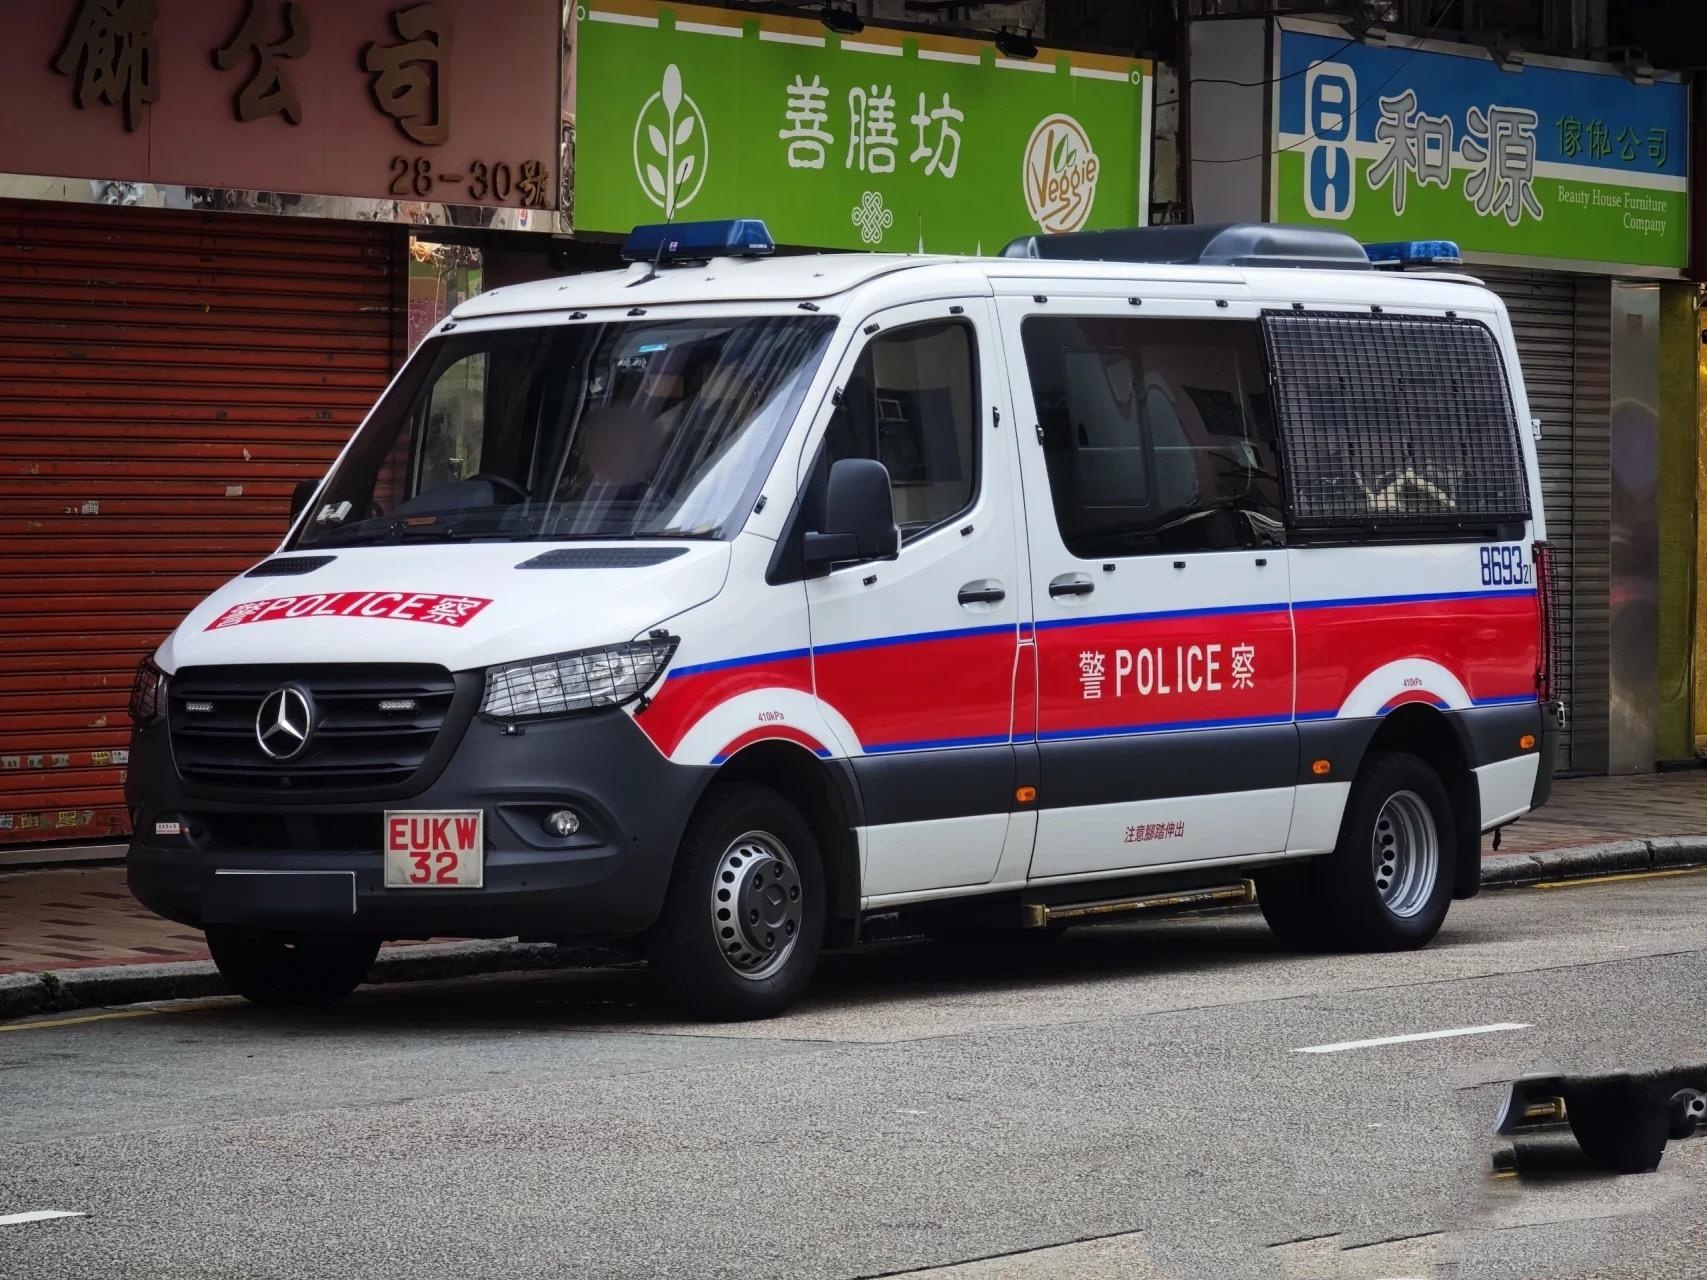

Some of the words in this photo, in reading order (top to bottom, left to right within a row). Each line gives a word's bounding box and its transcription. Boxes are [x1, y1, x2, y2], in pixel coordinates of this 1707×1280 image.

[778, 73, 965, 179] 善膳坊
[1366, 88, 1543, 226] 和源
[1031, 129, 1096, 225] Veggie
[1558, 185, 1590, 209] Beauty
[1592, 189, 1622, 208] House
[1624, 192, 1667, 213] Furniture
[1623, 212, 1667, 237] Company
[1480, 546, 1523, 585] 8693
[252, 593, 442, 621] POLICE
[1079, 651, 1106, 699] 警
[1115, 644, 1222, 697] POLICE
[1231, 643, 1256, 690] 察
[758, 711, 785, 721] 410kPa
[390, 818, 477, 850] EUKW
[410, 852, 458, 884] 32
